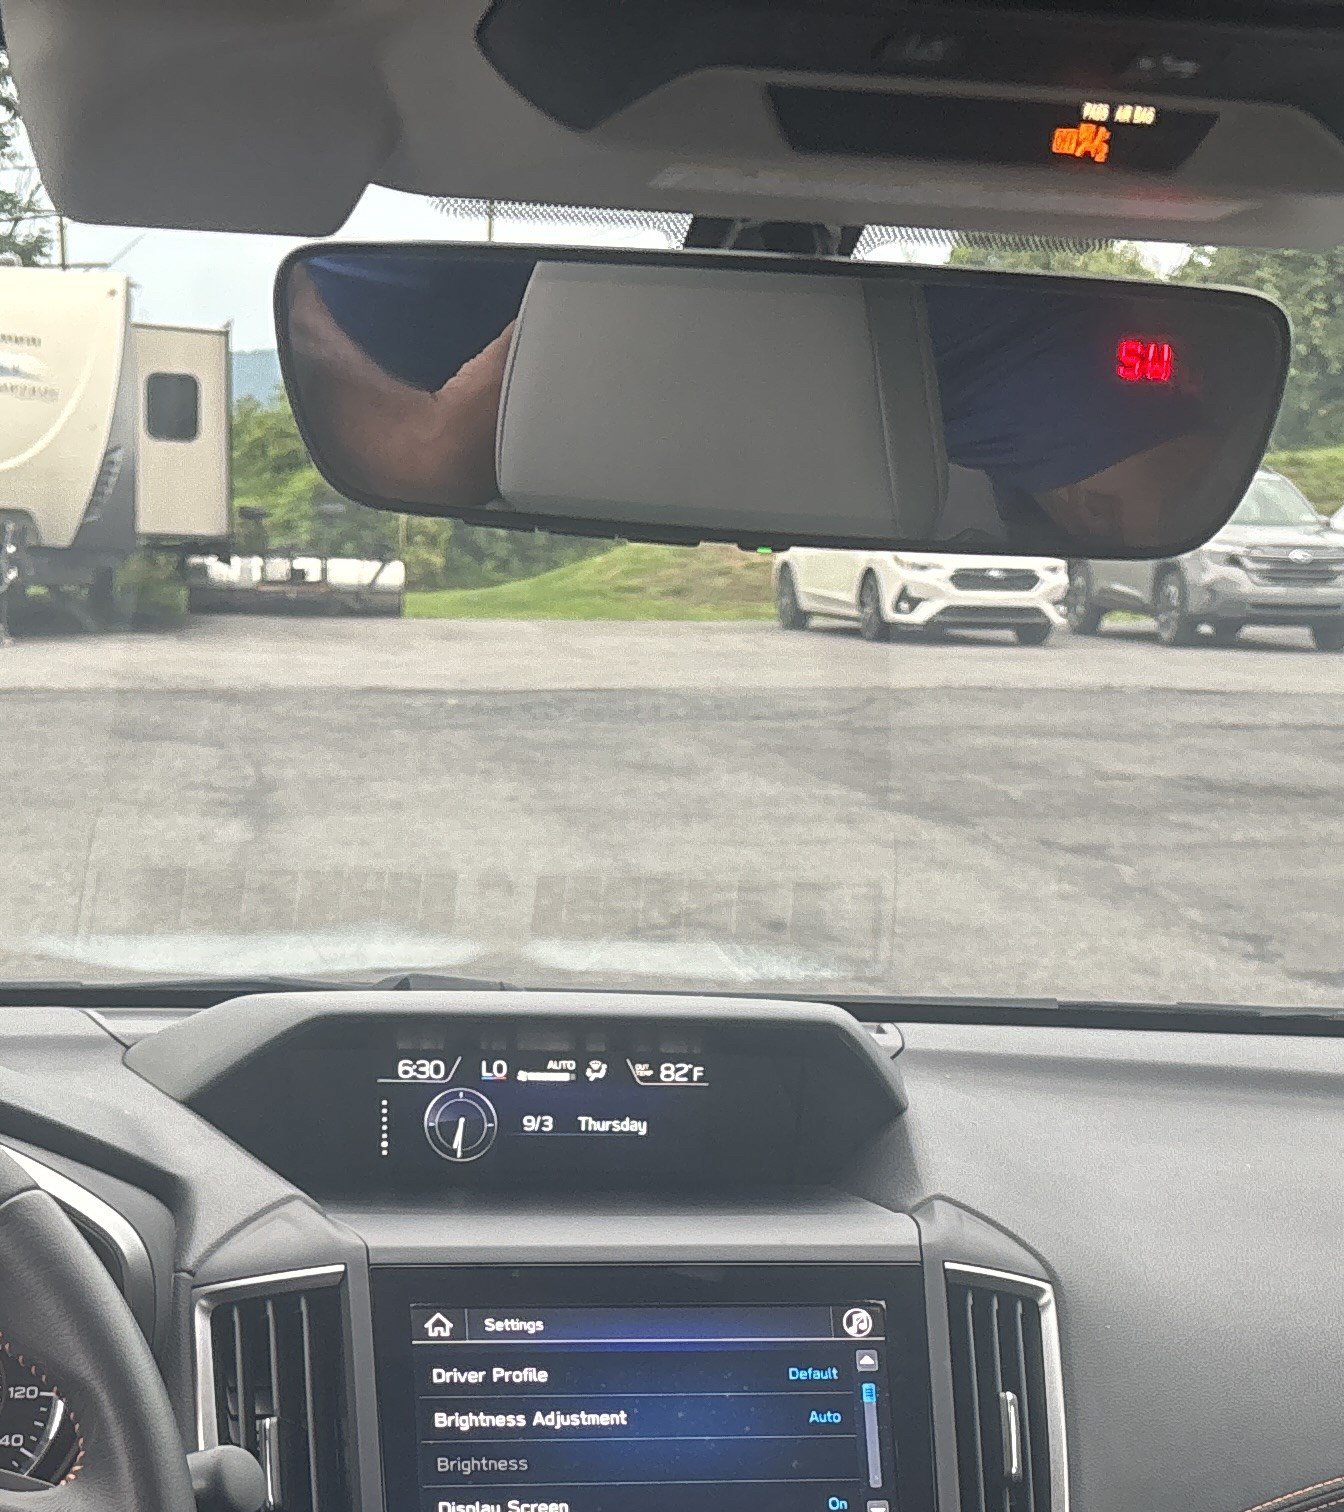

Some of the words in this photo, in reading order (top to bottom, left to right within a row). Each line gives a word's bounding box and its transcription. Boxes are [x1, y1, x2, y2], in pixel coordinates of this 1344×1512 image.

[1117, 339, 1172, 381] SW
[397, 1060, 446, 1079] 6:30
[481, 1060, 507, 1078] LO
[547, 1060, 576, 1071] AUTO
[522, 1116, 554, 1132] 9/3
[577, 1116, 648, 1135] Thursday
[484, 1317, 544, 1334] Settings
[432, 1367, 485, 1384] Driver
[492, 1366, 548, 1383] Profile
[788, 1366, 838, 1381] Default
[7, 1386, 39, 1400] 120
[434, 1411, 526, 1430] Brightness
[533, 1409, 628, 1429] Adjustment
[809, 1410, 842, 1424] Auto
[436, 1456, 528, 1474] Brightness
[828, 1497, 848, 1511] On
